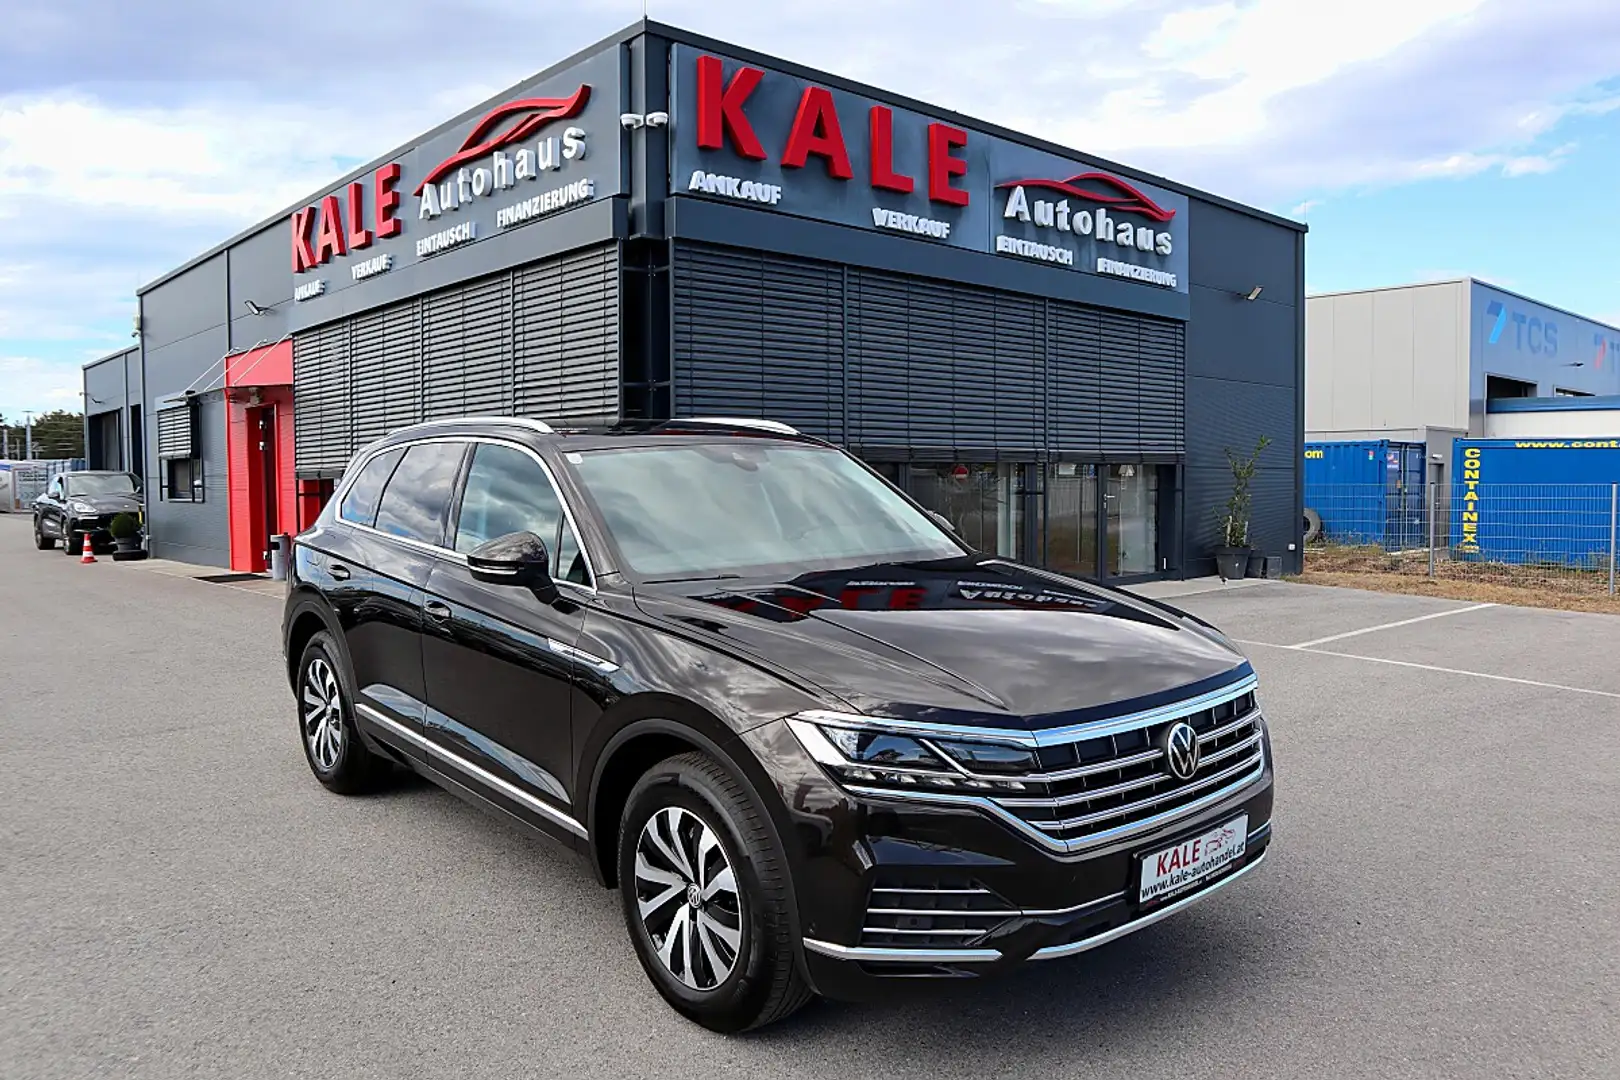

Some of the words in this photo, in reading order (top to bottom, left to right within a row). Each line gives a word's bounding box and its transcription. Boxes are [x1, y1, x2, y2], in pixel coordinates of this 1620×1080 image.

[697, 55, 969, 207] KALE
[418, 126, 587, 220] Autohaus
[688, 170, 783, 206] ANKAUF
[872, 207, 951, 240] VERKAUF
[291, 163, 402, 273] KALE
[351, 253, 393, 280] VERKAUF
[416, 221, 477, 257] EINTAUSCH
[496, 178, 595, 228] FINANZIERUNG
[1004, 185, 1173, 255] Autohaus
[996, 235, 1073, 266] EINTAUSCH
[1097, 257, 1177, 288] FINANZIERUNG
[1512, 311, 1558, 358] TCS
[1515, 440, 1620, 449] www.cont
[1462, 448, 1481, 543] CONTAINEX
[1156, 839, 1202, 878] KALE
